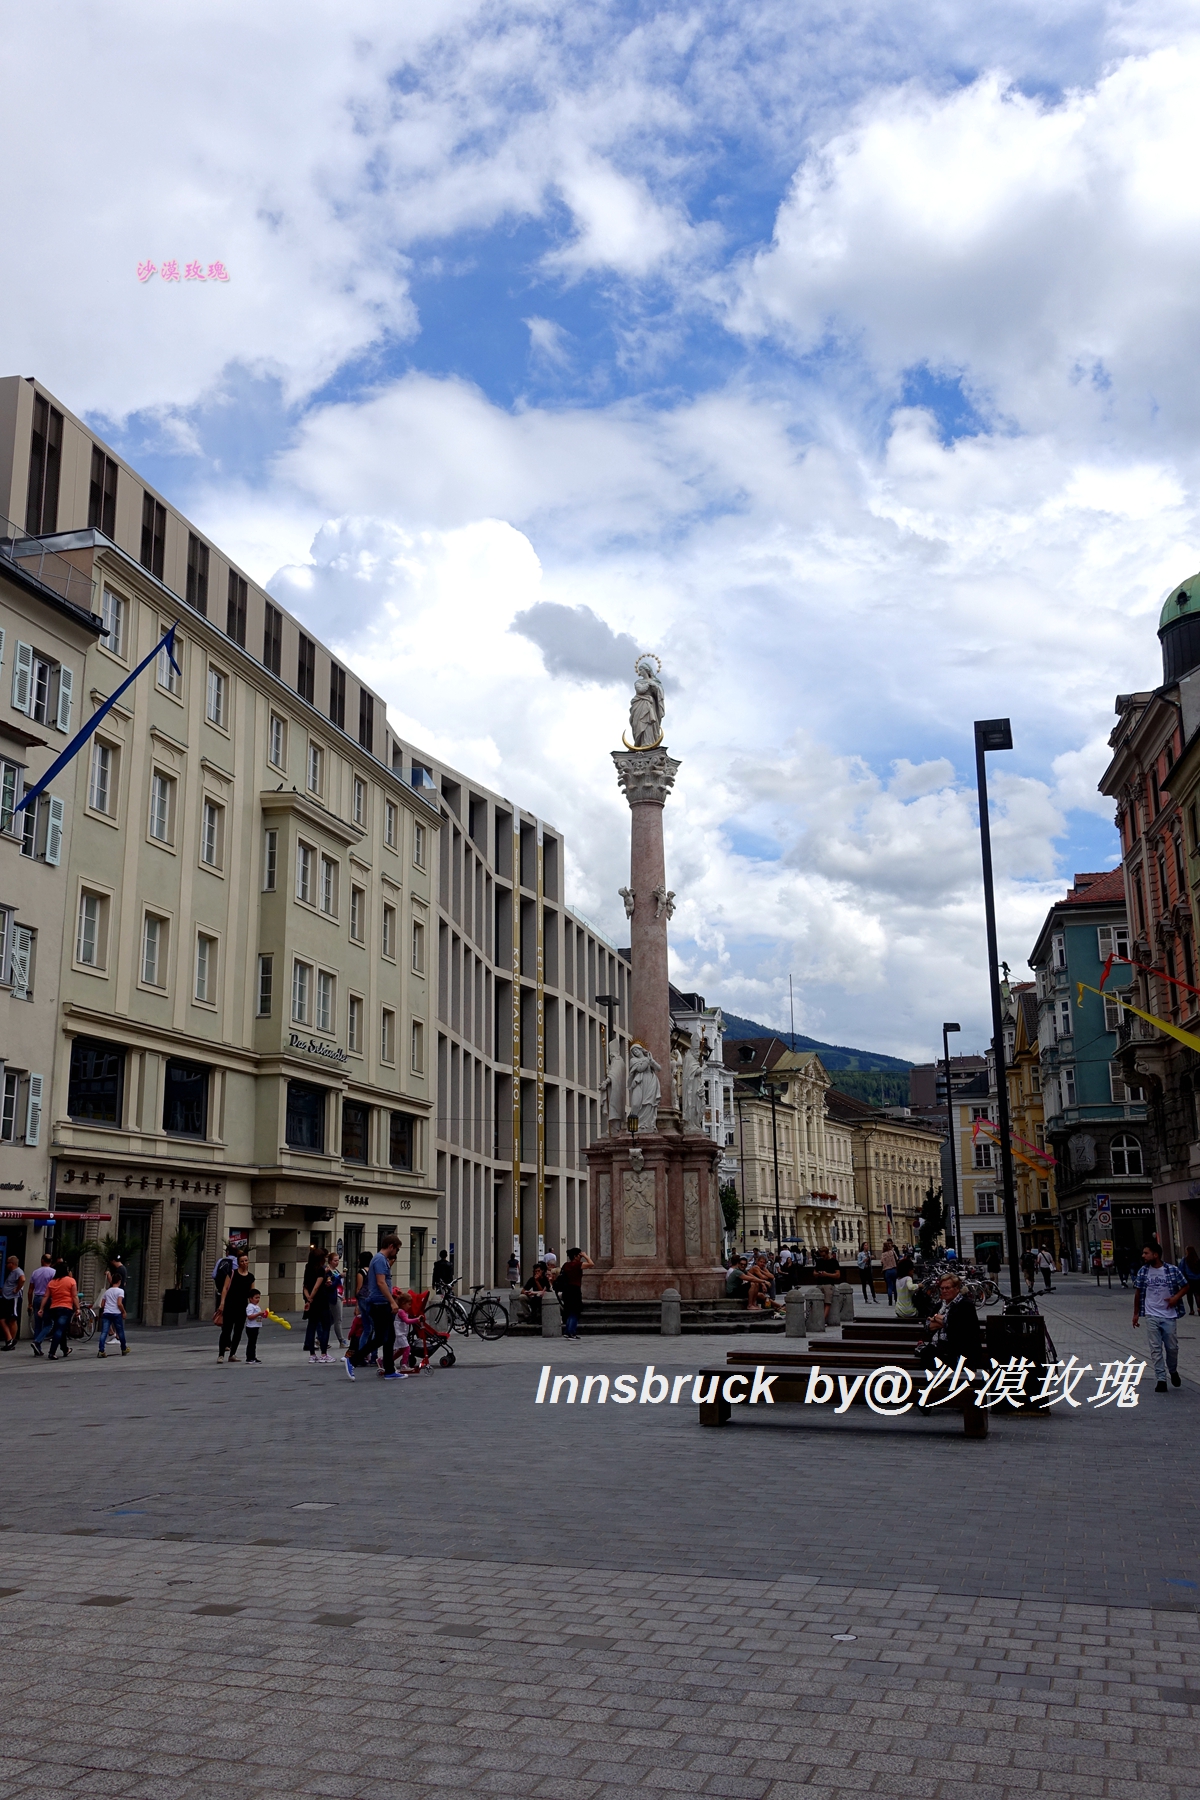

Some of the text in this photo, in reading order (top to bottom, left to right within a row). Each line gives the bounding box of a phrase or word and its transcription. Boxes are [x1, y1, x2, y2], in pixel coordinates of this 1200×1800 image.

[64, 1169, 222, 1196] BAR CENTRALE
[345, 1195, 370, 1206] TABAK
[400, 1199, 412, 1210] COS
